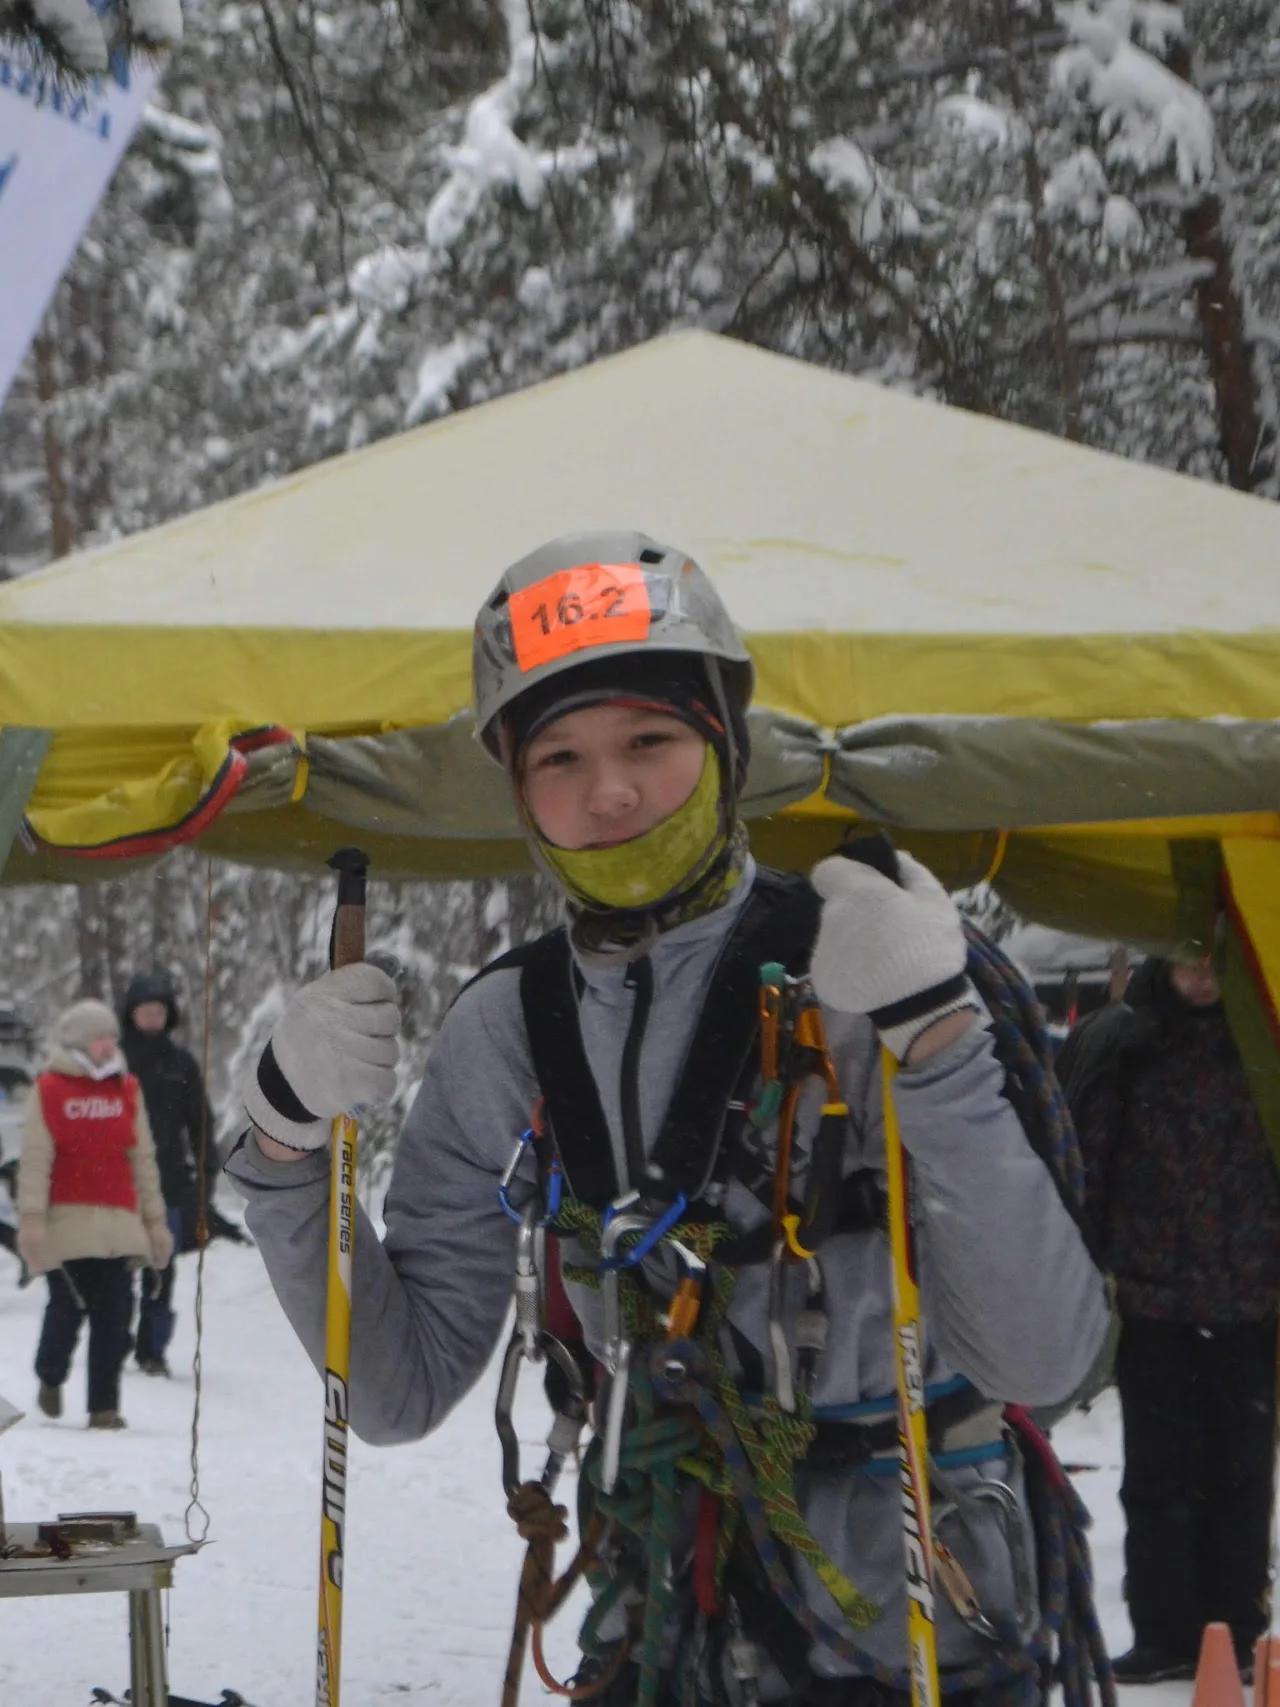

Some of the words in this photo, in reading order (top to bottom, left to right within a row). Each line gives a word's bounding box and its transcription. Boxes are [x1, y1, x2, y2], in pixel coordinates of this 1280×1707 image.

[531, 585, 630, 636] 16.2
[341, 1141, 353, 1186] race
[340, 1192, 352, 1254] series
